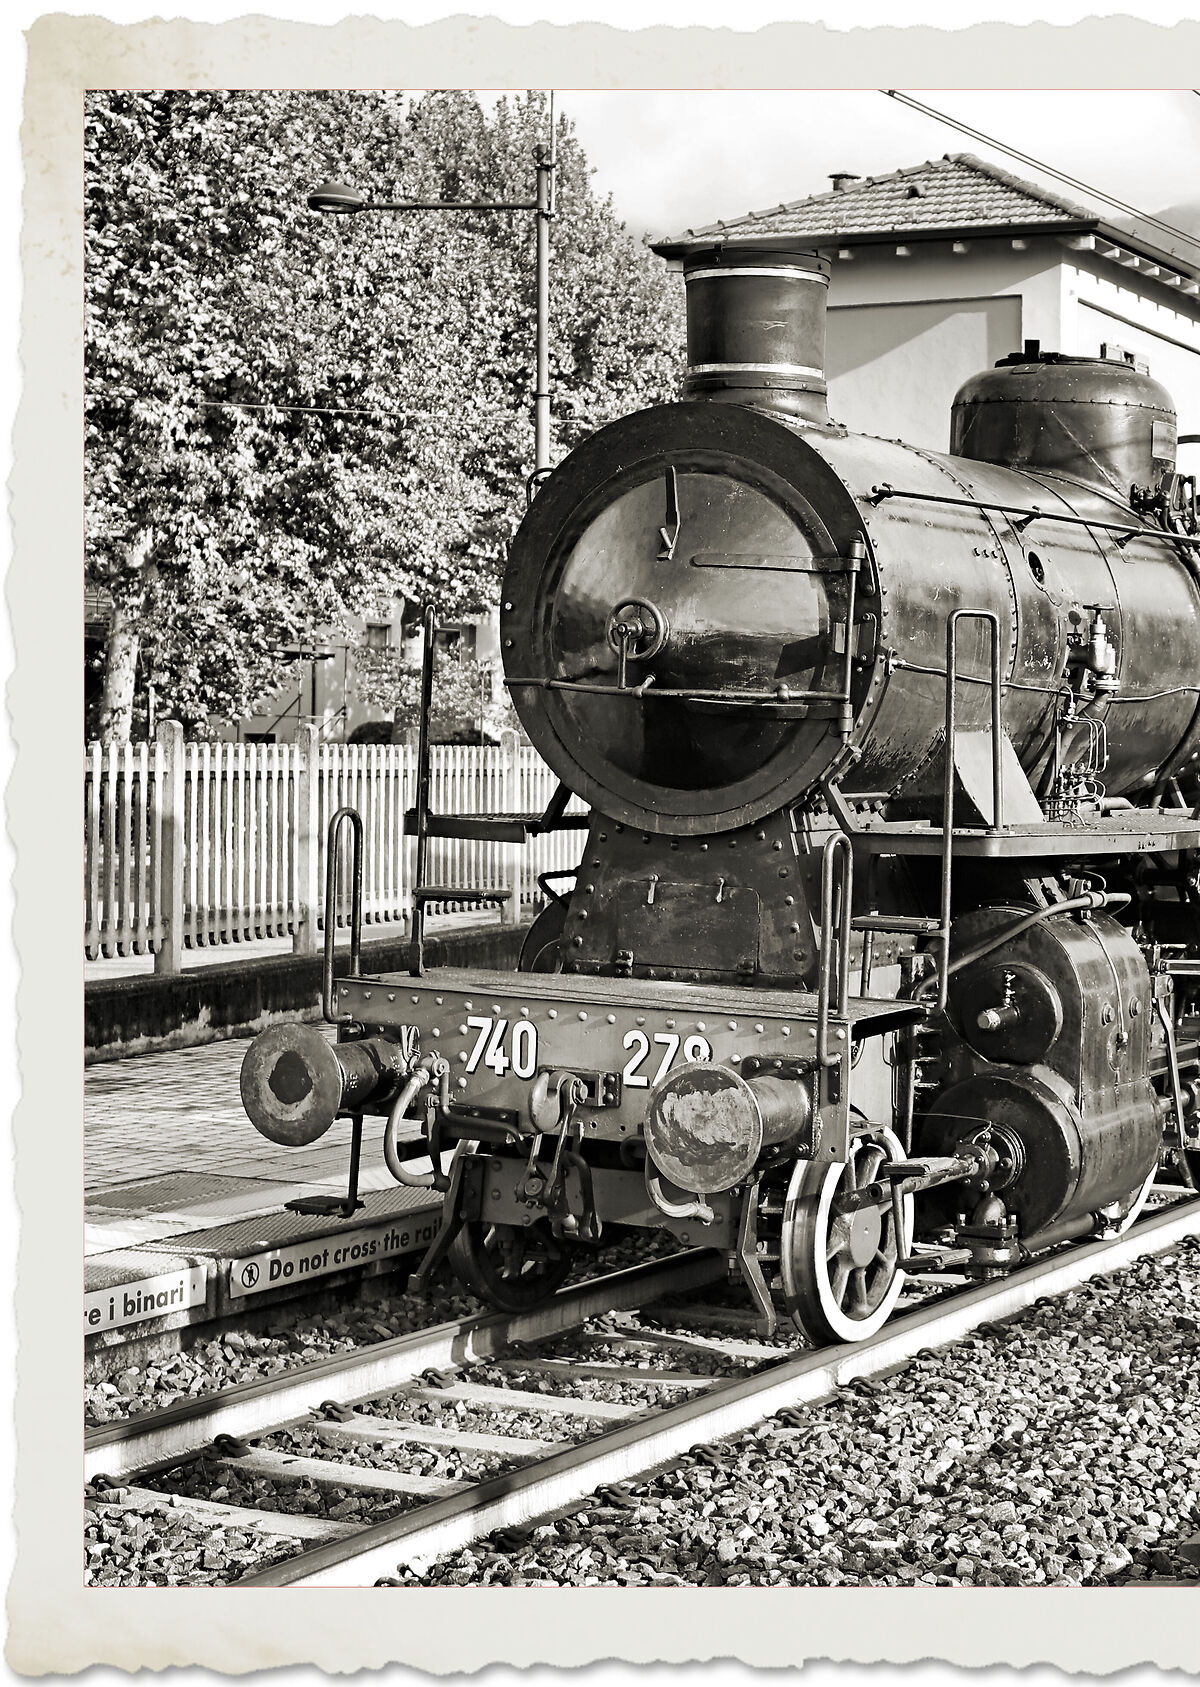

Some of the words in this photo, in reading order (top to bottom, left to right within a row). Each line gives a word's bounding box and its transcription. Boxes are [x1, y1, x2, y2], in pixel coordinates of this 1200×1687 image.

[465, 1016, 538, 1079] 740
[269, 1259, 294, 1281] Do
[299, 1249, 329, 1273] not
[334, 1239, 377, 1264] cross
[383, 1229, 409, 1251] the
[84, 1308, 101, 1326] e
[109, 1296, 115, 1321] i
[123, 1280, 184, 1317] binari
